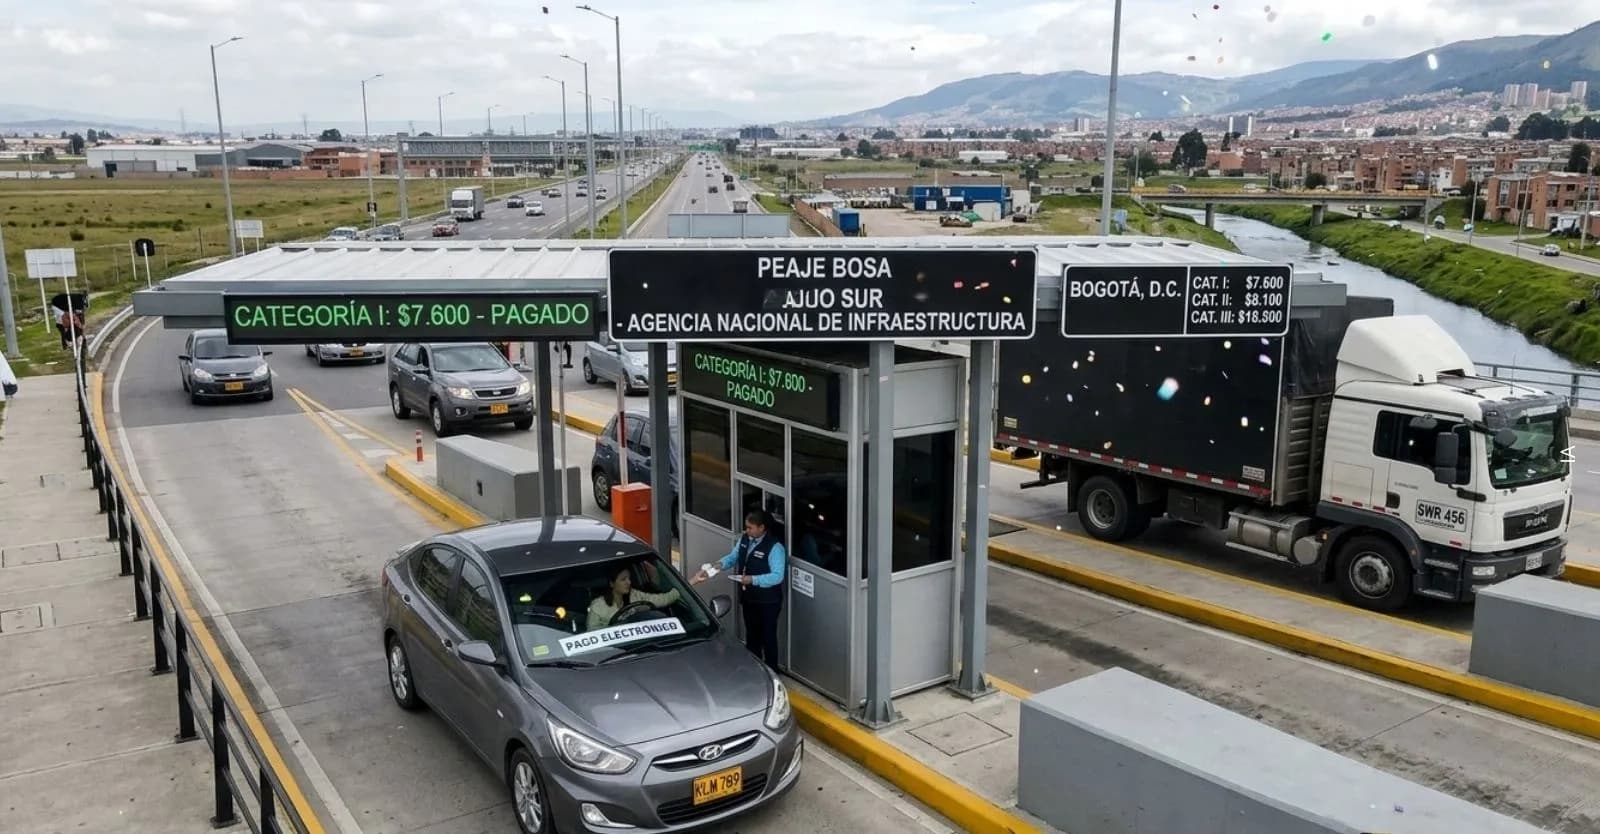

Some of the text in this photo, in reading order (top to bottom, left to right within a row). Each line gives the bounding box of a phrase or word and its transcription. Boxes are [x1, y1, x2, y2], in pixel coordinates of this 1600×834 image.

[757, 257, 893, 279] PEAJE BOSA
[1069, 275, 1182, 300] BOGOTÁ, D.C.
[1193, 275, 1284, 290] CAT. I: $7.600
[840, 287, 884, 309] SUR
[1192, 292, 1283, 307] CAT. II: $8.100
[234, 299, 373, 327] CATEGORÍA
[379, 304, 391, 327] I:
[397, 303, 471, 327] $7.600
[491, 303, 590, 325] PAGADO
[626, 313, 714, 333] AGENCIA
[716, 313, 814, 333] NACIONAL
[818, 313, 843, 332] DE
[848, 312, 1027, 332] INFRAESTRUCTURA
[1191, 310, 1217, 324] CAT.
[1221, 310, 1235, 324] III:
[694, 353, 758, 382] CATEGORÍA
[726, 380, 775, 408] PAGADO
[1417, 503, 1442, 520] SWR
[1443, 509, 1465, 525] 456
[719, 771, 740, 791] 789
